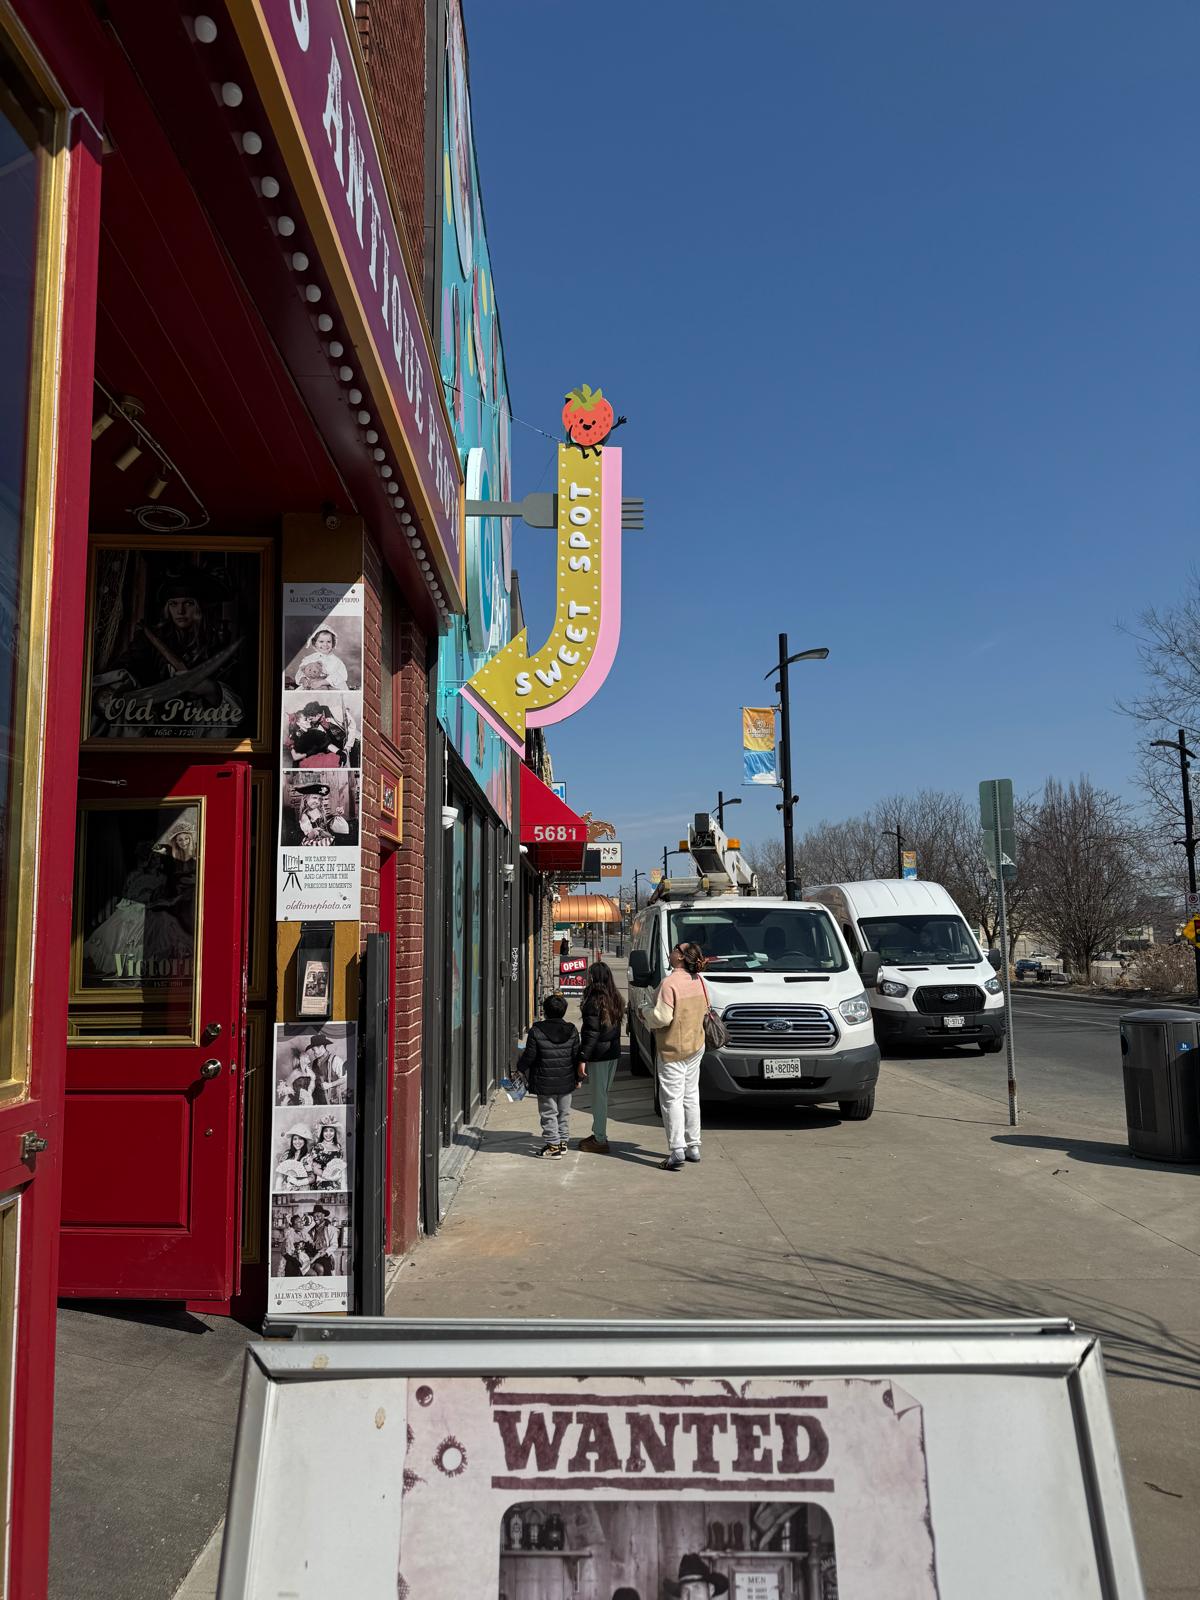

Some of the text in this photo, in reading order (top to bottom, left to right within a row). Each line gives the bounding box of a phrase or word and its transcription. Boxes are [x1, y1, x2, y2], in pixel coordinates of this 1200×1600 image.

[322, 37, 460, 555] ANTIQUE PHOTO
[515, 481, 592, 695] SWEET SPOT
[104, 698, 244, 722] Old Pirate
[533, 825, 577, 841] 5681
[304, 863, 356, 872] BACK IN TIME
[285, 900, 352, 914] oldtimephoto.ca
[563, 960, 585, 971] OPEN
[274, 1292, 303, 1300] ALLWAYS
[303, 1291, 330, 1300] ANTIQUE
[492, 1410, 830, 1474] WANTED
